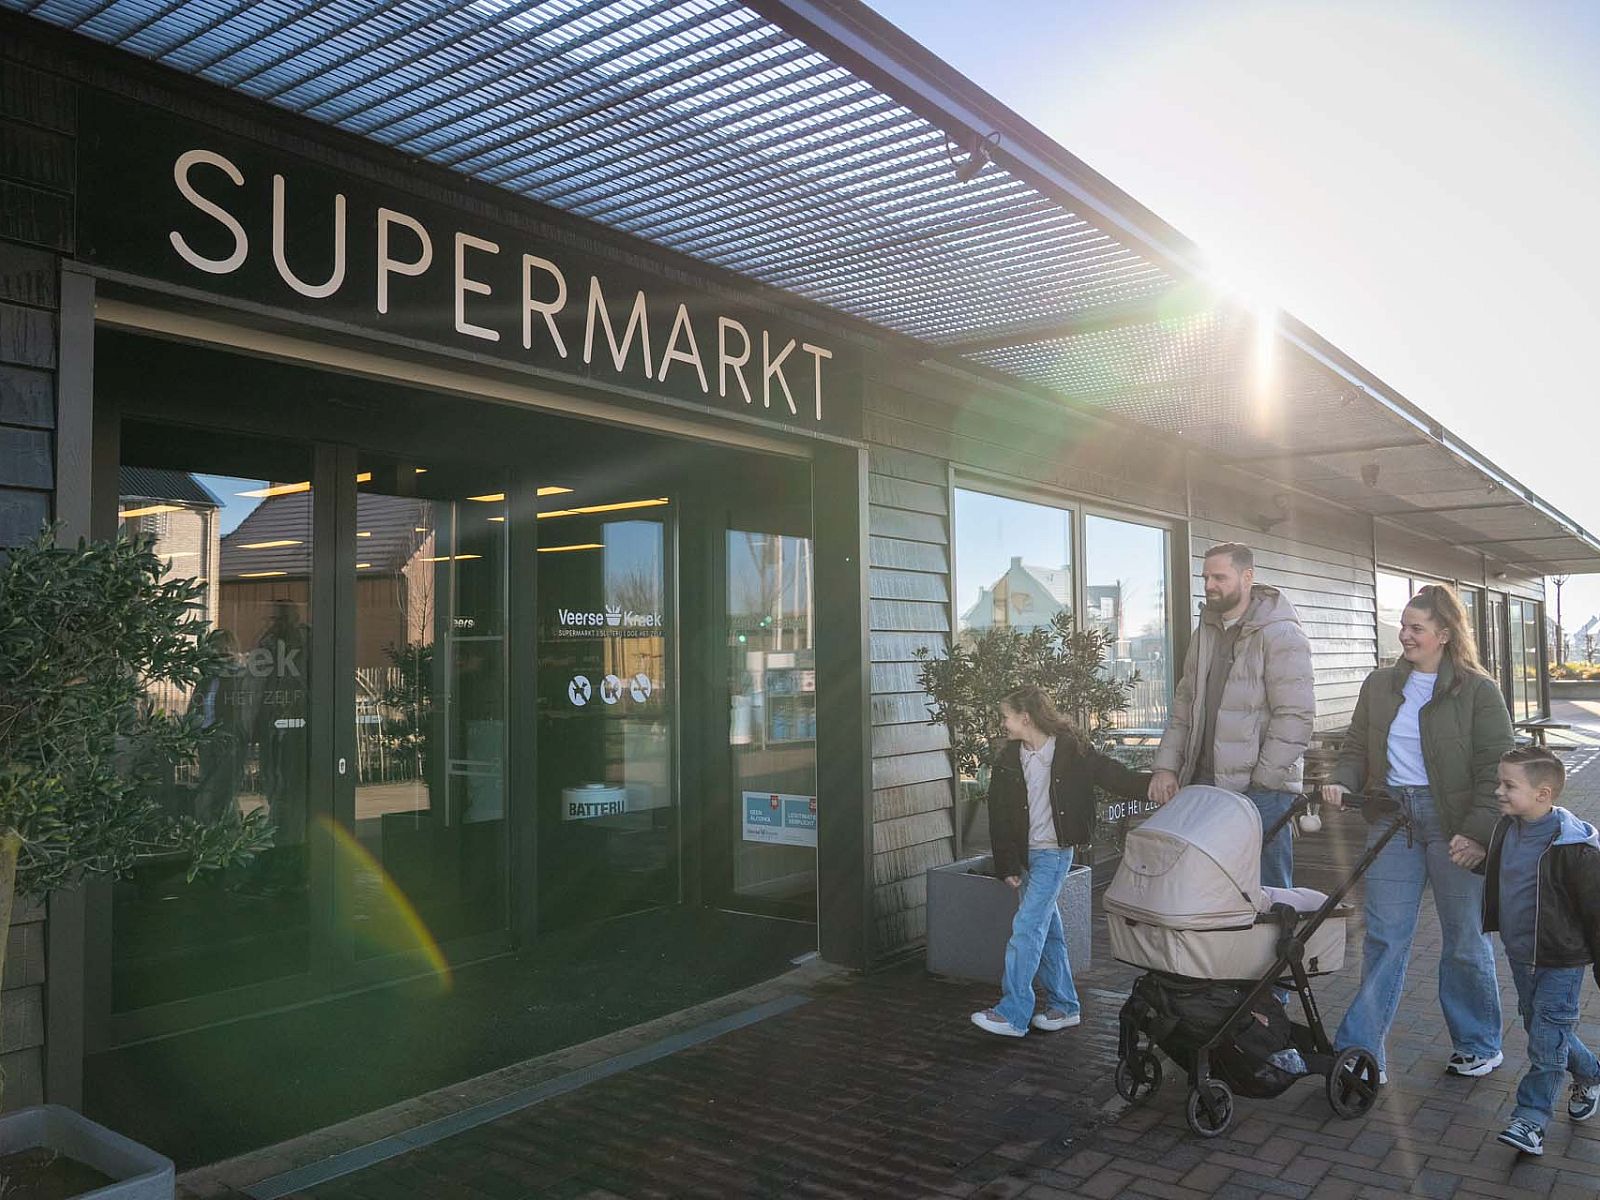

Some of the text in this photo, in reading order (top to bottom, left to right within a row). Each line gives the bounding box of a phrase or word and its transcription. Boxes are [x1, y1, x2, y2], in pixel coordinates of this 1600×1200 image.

[169, 149, 834, 421] SUPERMARKT
[558, 608, 662, 627] Veerse Kreek
[558, 629, 595, 637] SUPERMARKT
[224, 689, 255, 706] HET
[263, 689, 304, 705] ZELF
[1109, 803, 1125, 819] DOE
